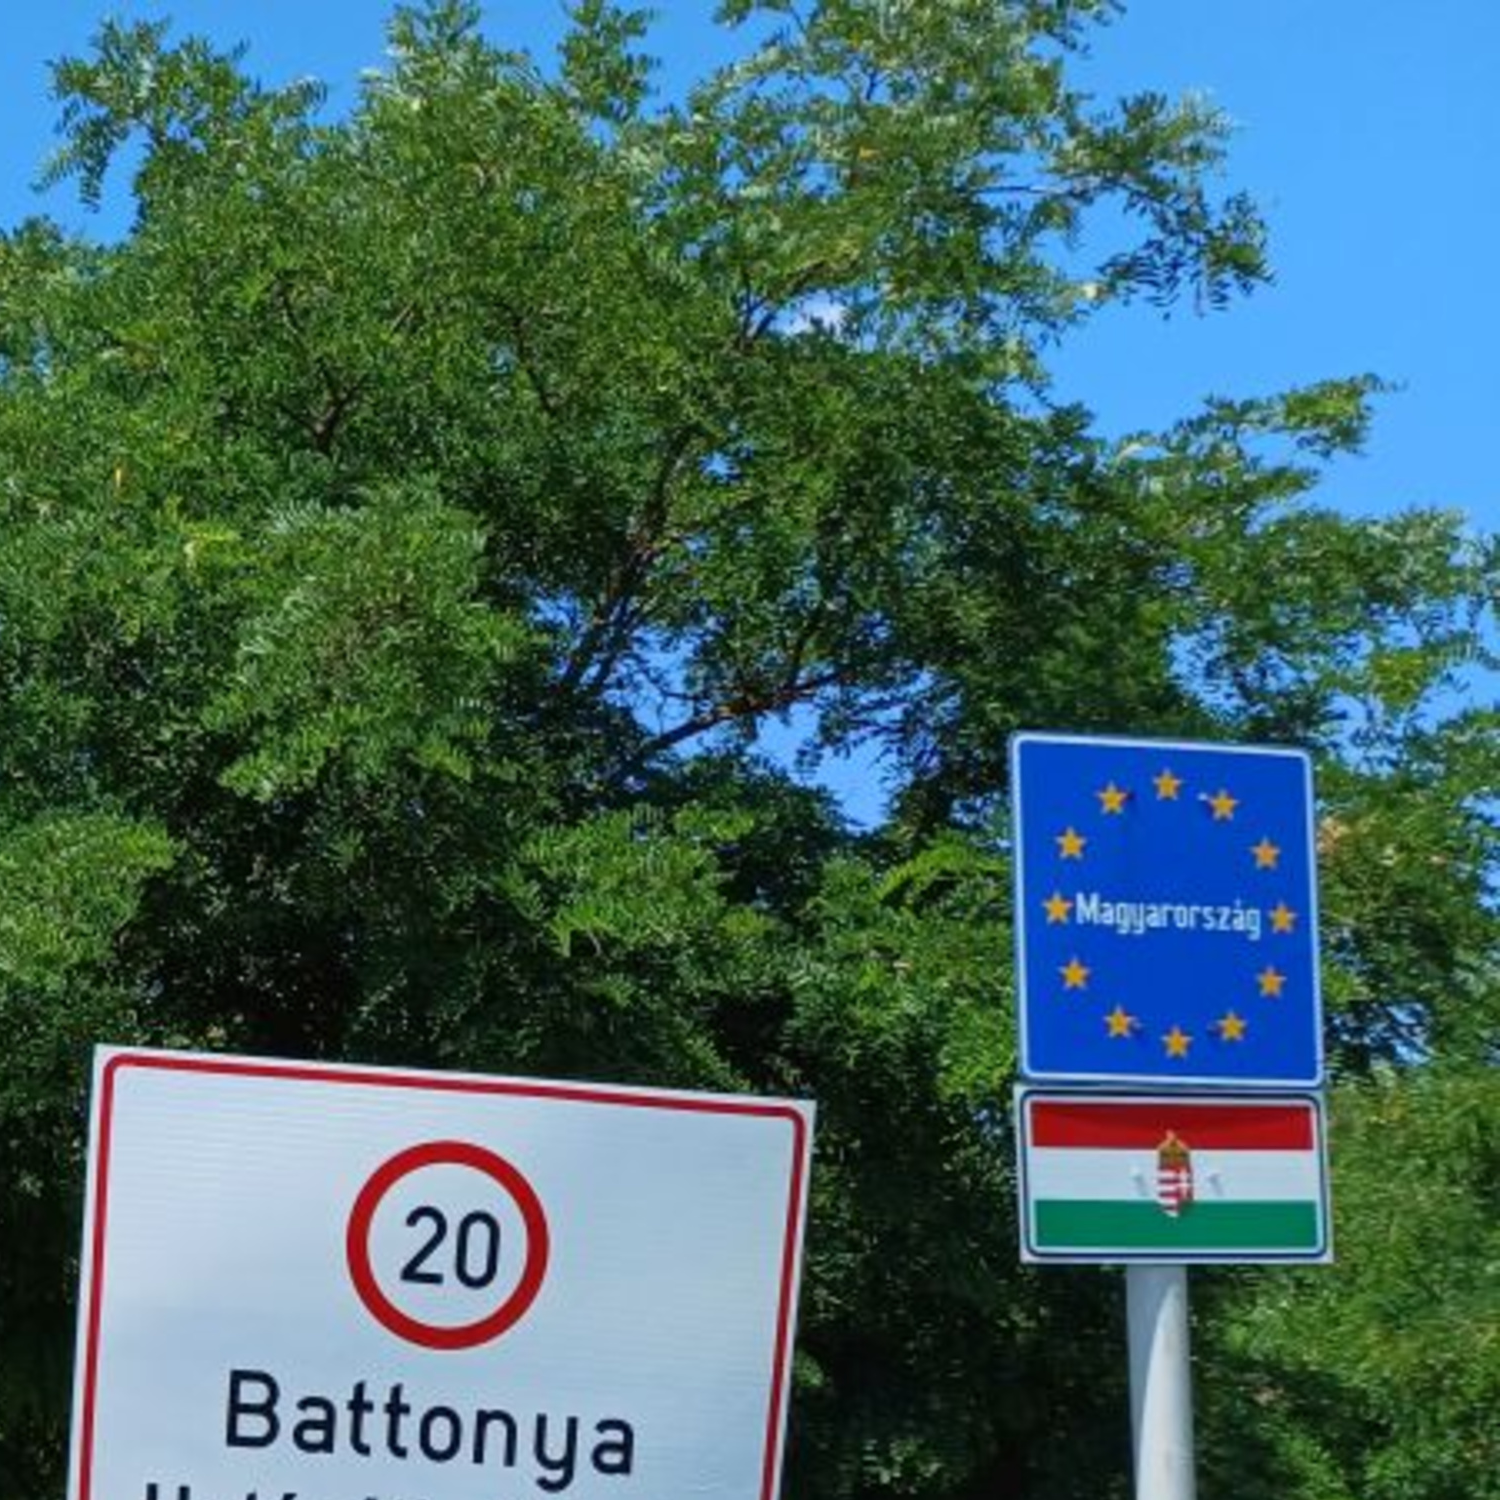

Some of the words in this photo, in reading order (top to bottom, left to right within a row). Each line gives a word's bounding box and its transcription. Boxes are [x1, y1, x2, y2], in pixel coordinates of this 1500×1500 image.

[1076, 892, 1261, 940] Magyarország
[400, 1205, 501, 1290] 20
[225, 1369, 635, 1494] Battonya
